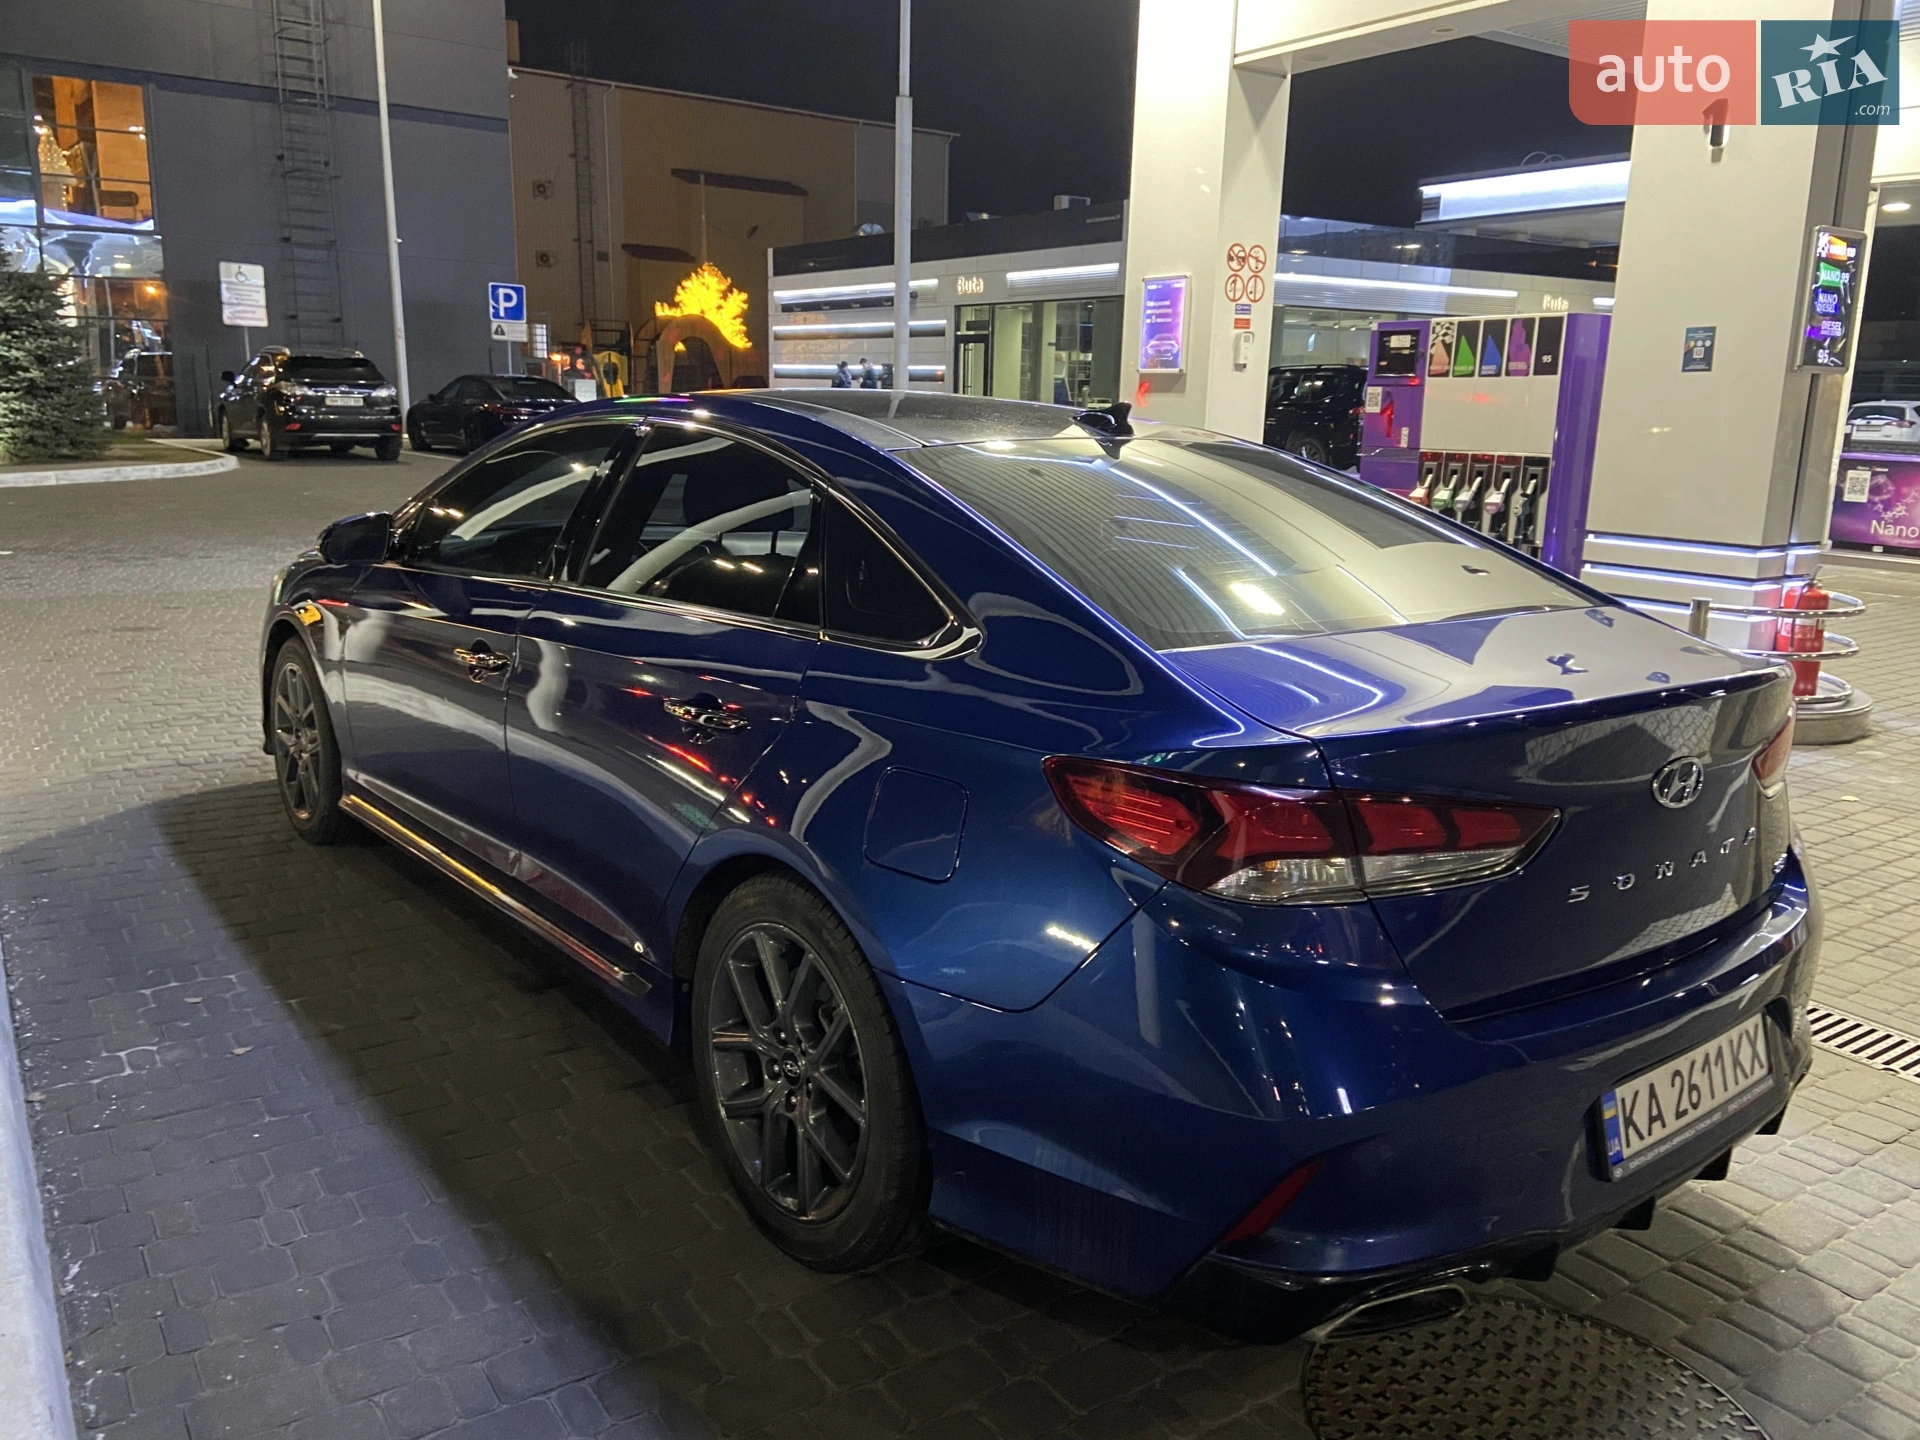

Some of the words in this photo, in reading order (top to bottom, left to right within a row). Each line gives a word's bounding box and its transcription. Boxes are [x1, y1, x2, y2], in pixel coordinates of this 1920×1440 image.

[1702, 98, 1728, 147] 1
[1820, 269, 1841, 283] NANO
[1841, 272, 1850, 284] 95
[498, 288, 518, 317] P
[1818, 292, 1838, 304] NANO
[1821, 320, 1842, 331] DIESEL
[1542, 355, 1552, 363] 95
[1817, 349, 1829, 364] 95
[1870, 519, 1920, 538] Nano
[1567, 827, 1757, 903] SONATA
[1621, 1082, 1667, 1149] KA
[1671, 1045, 1729, 1121] 2611
[1729, 1023, 1765, 1086] KX
[1607, 1139, 1622, 1156] UA
